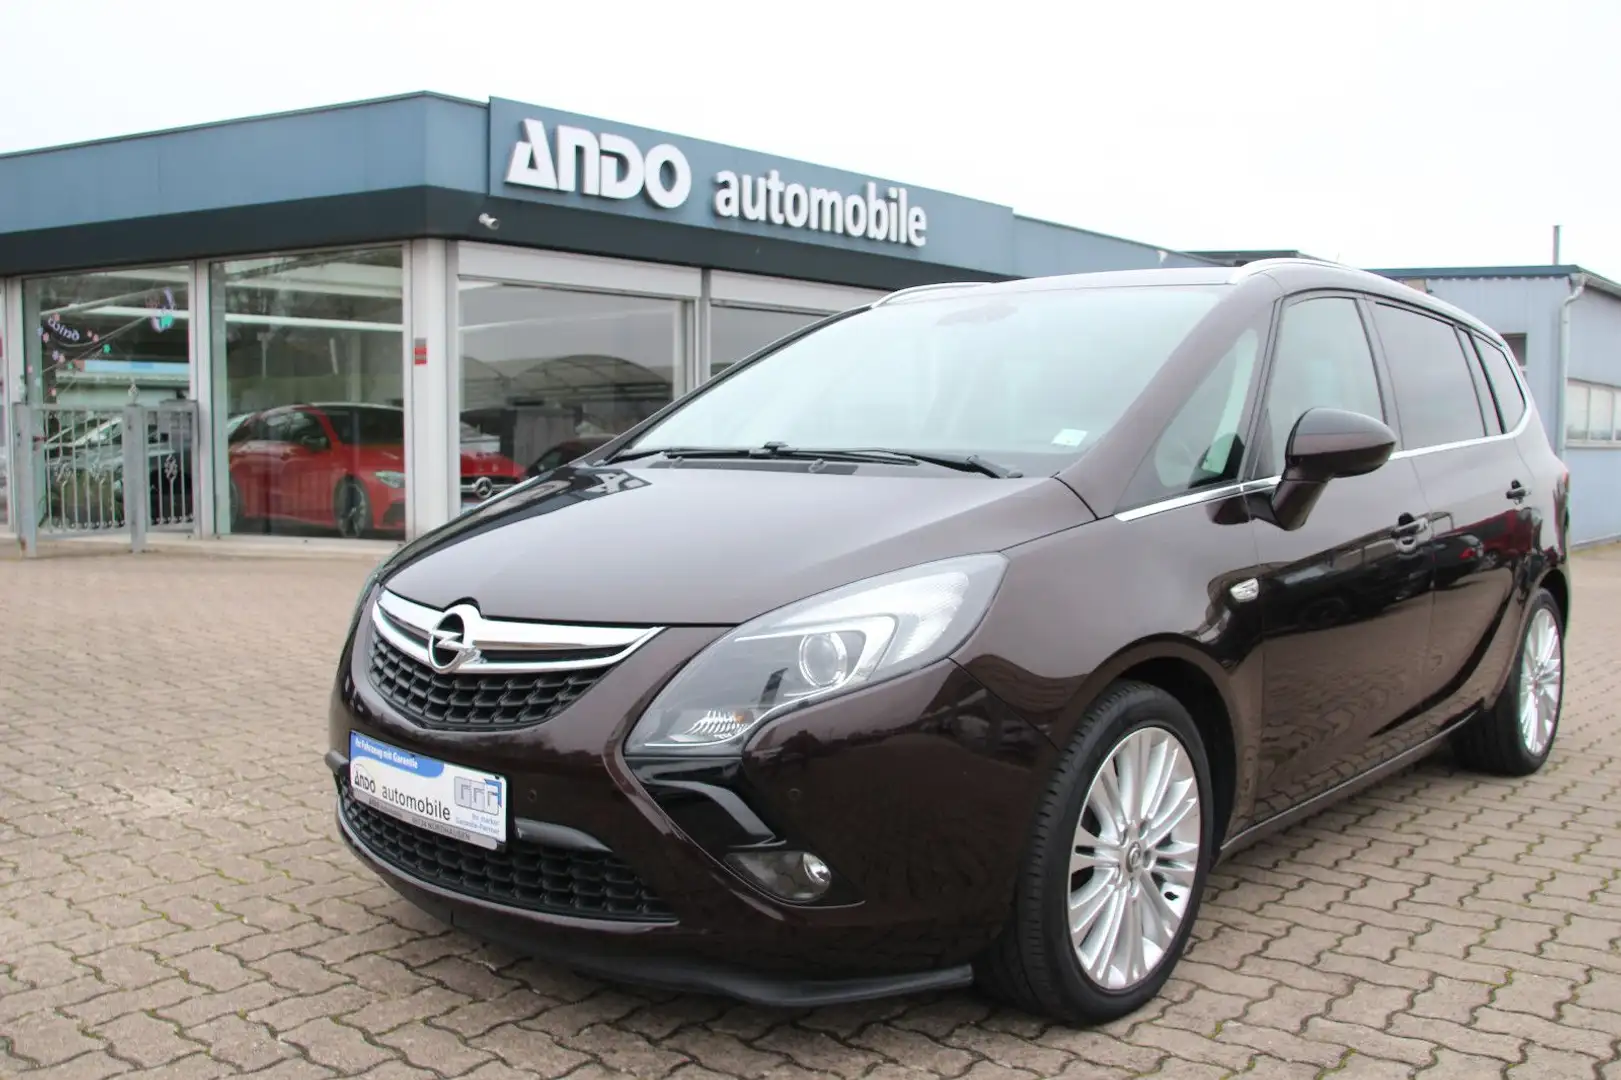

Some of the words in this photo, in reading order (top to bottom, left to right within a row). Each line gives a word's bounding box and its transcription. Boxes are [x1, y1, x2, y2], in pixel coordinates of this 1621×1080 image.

[504, 117, 692, 209] ANDO
[714, 168, 927, 248] automobile
[360, 739, 383, 760] Fahrzeug
[393, 751, 418, 770] Garantie
[382, 785, 451, 820] automobile
